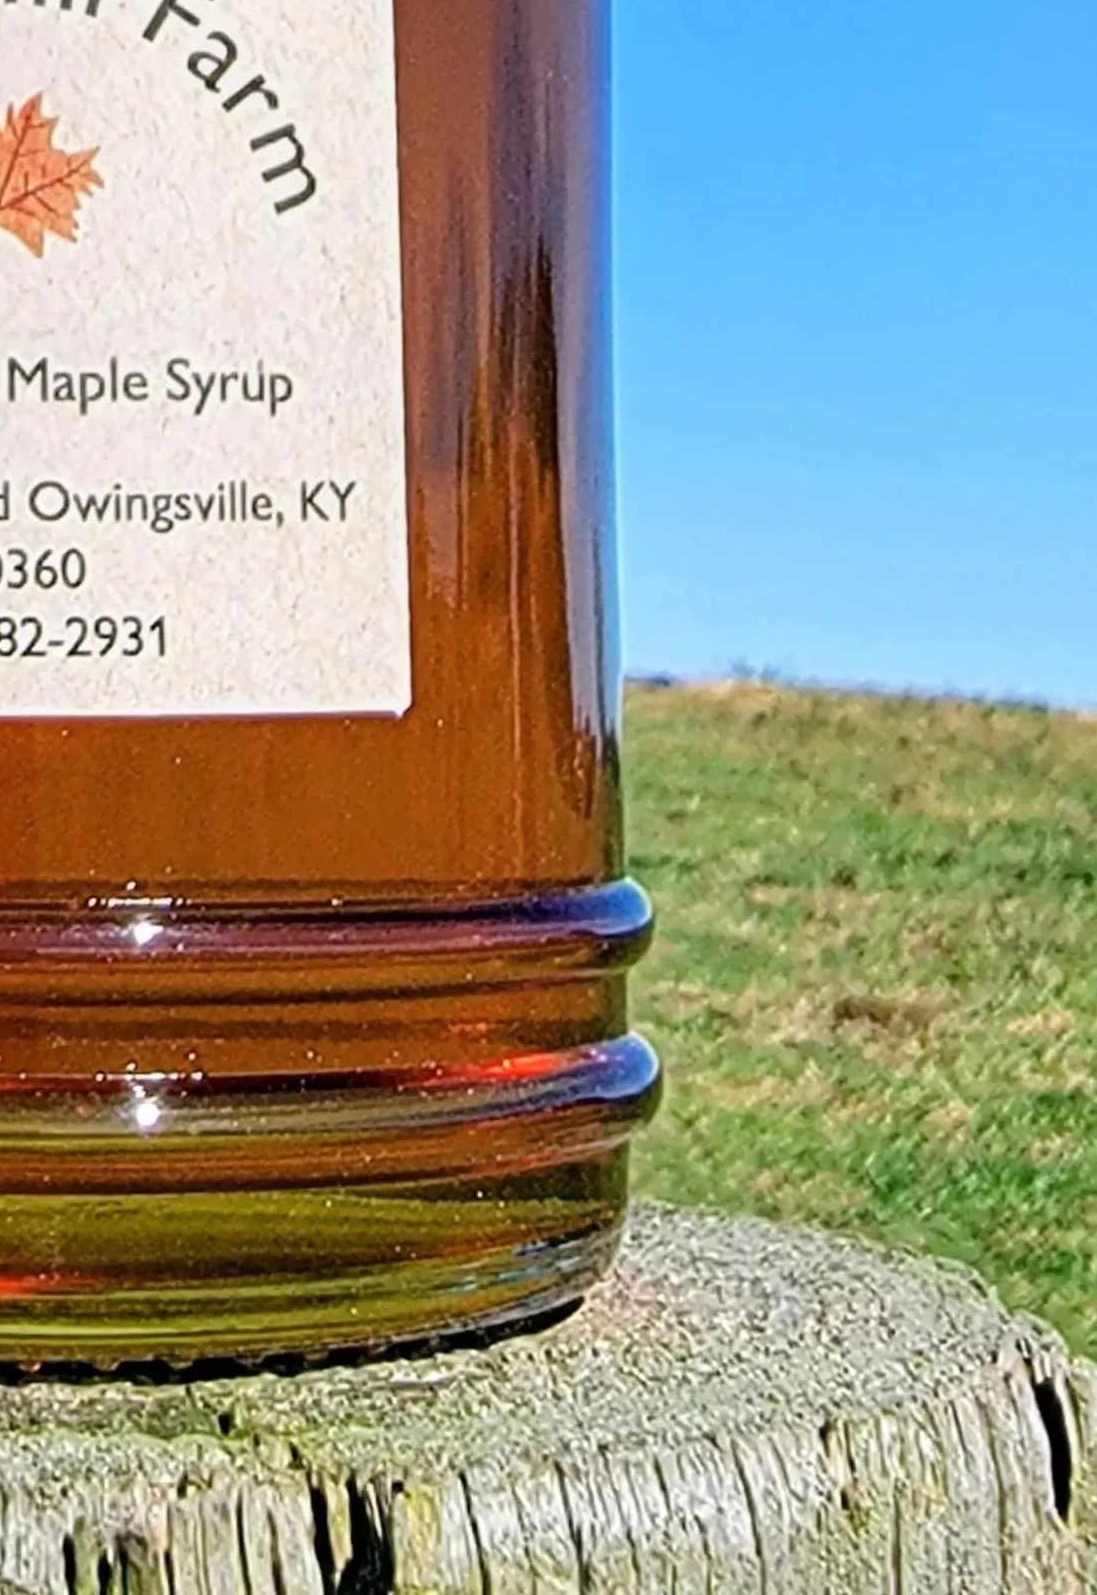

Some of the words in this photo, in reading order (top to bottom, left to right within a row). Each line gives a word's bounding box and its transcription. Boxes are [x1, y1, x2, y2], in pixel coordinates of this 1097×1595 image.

[7, 357, 149, 416] Maple
[166, 358, 294, 417] Syrup
[28, 481, 285, 535] Owingsville,
[300, 481, 356, 522] KY
